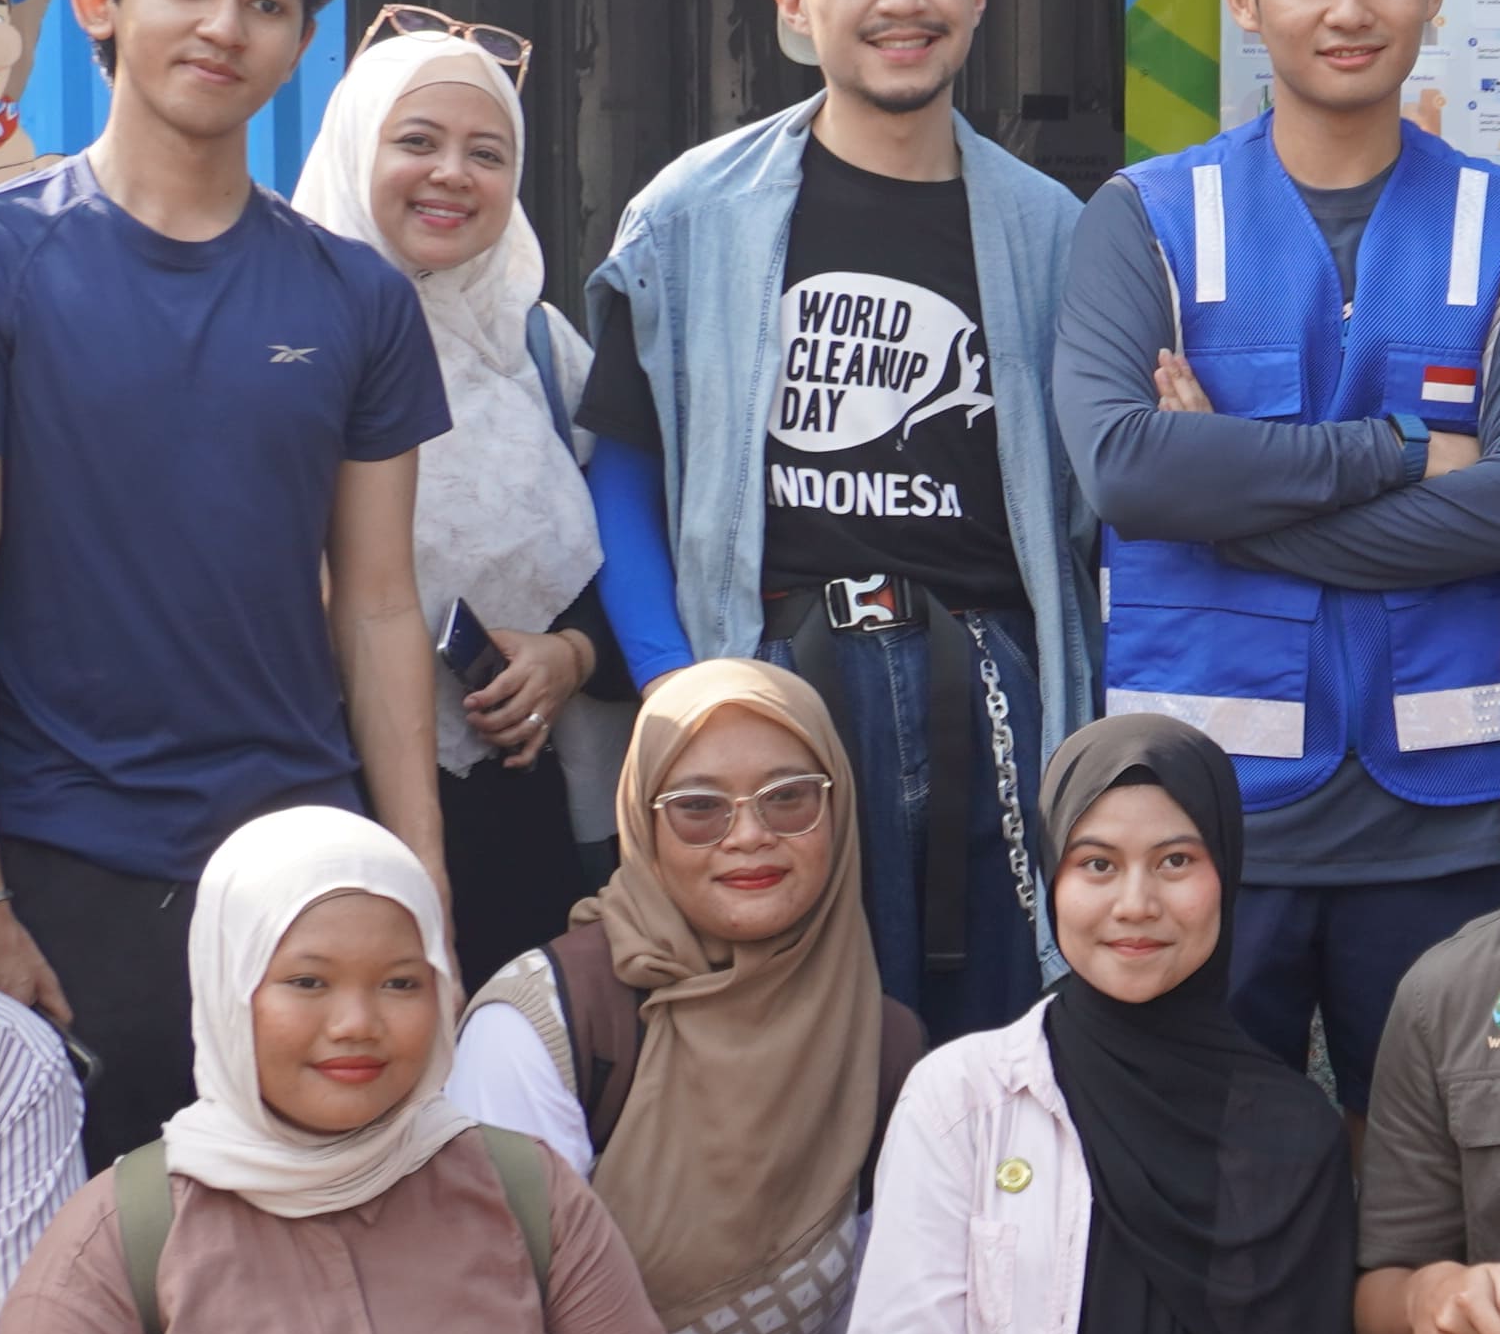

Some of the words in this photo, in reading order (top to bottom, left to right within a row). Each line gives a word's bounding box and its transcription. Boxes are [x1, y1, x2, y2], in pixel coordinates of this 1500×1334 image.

[800, 290, 911, 344] WORLD
[786, 338, 929, 394] CLEANUP
[780, 386, 847, 433] DAY
